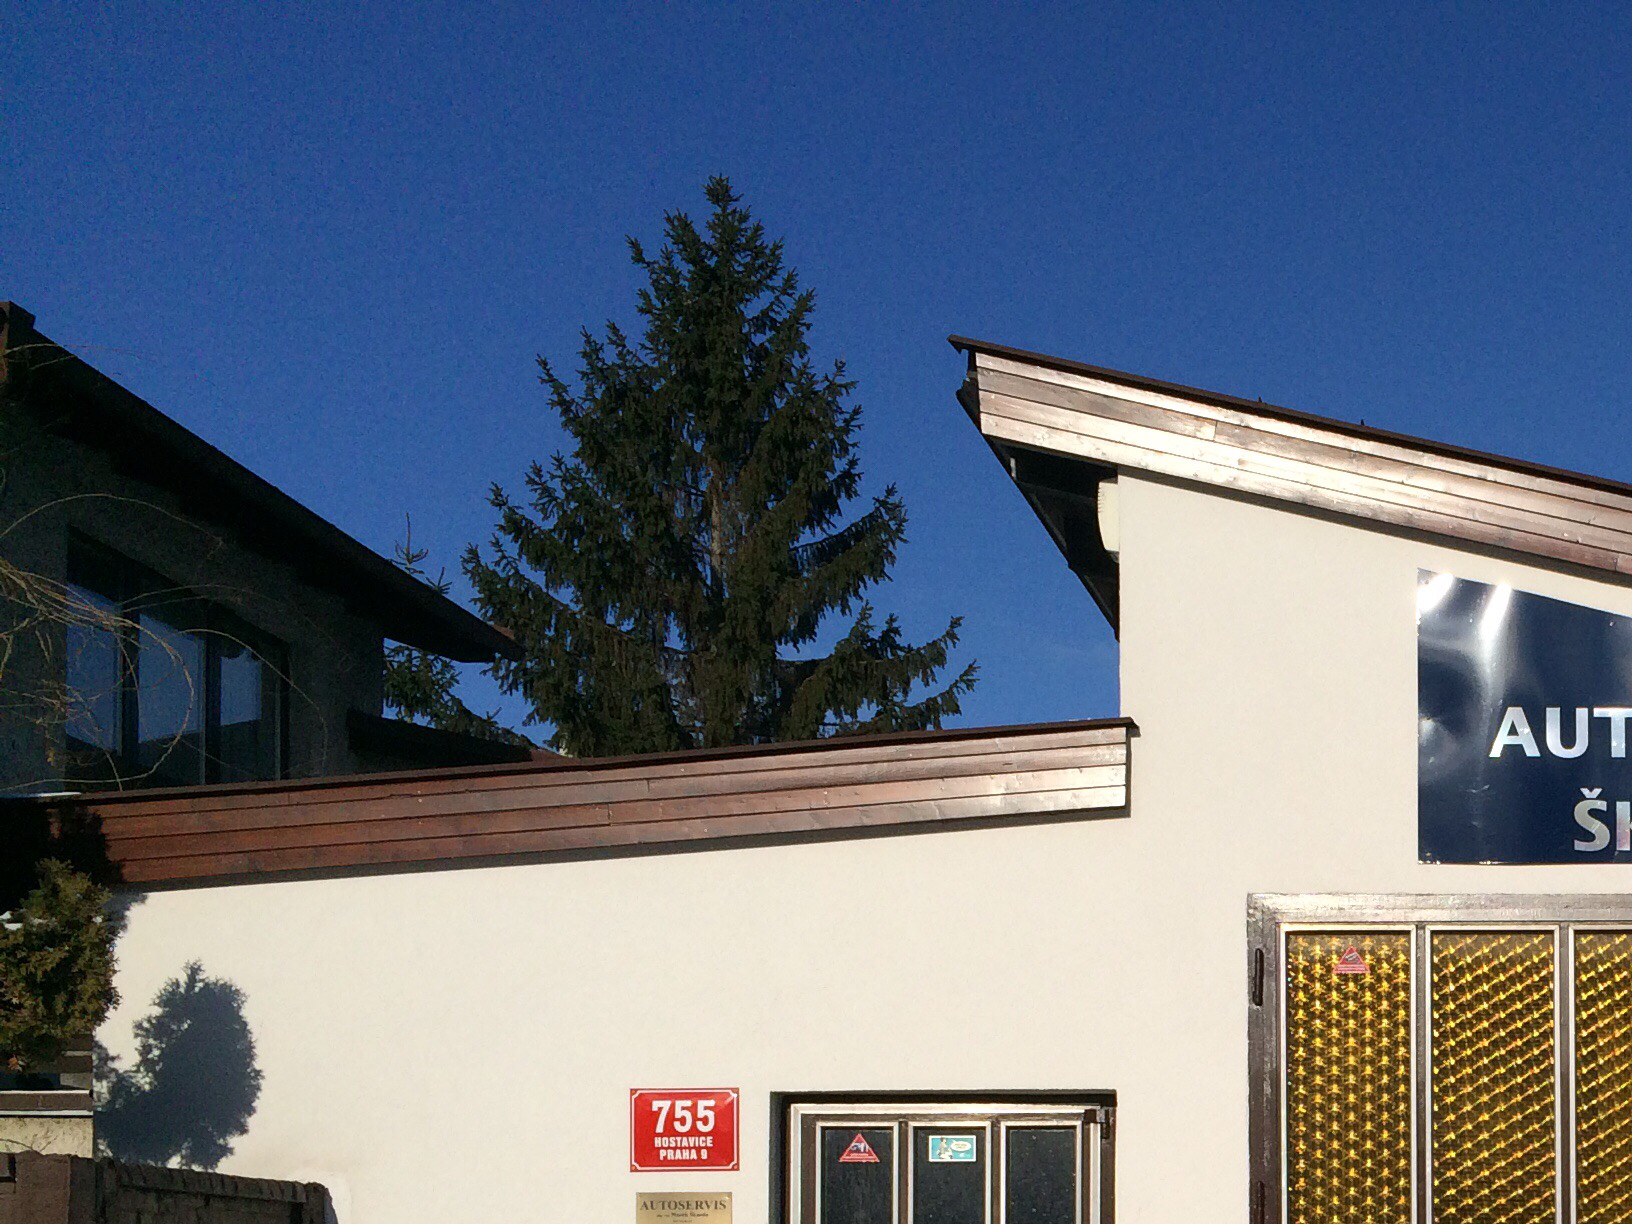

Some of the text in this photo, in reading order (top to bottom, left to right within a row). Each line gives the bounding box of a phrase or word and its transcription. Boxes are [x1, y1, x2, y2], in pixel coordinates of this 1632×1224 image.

[651, 1099, 717, 1134] 755
[654, 1136, 714, 1148] HOSTAVICE
[659, 1149, 708, 1161] PRAHA 9
[640, 1200, 727, 1211] AUTOSERVIS
